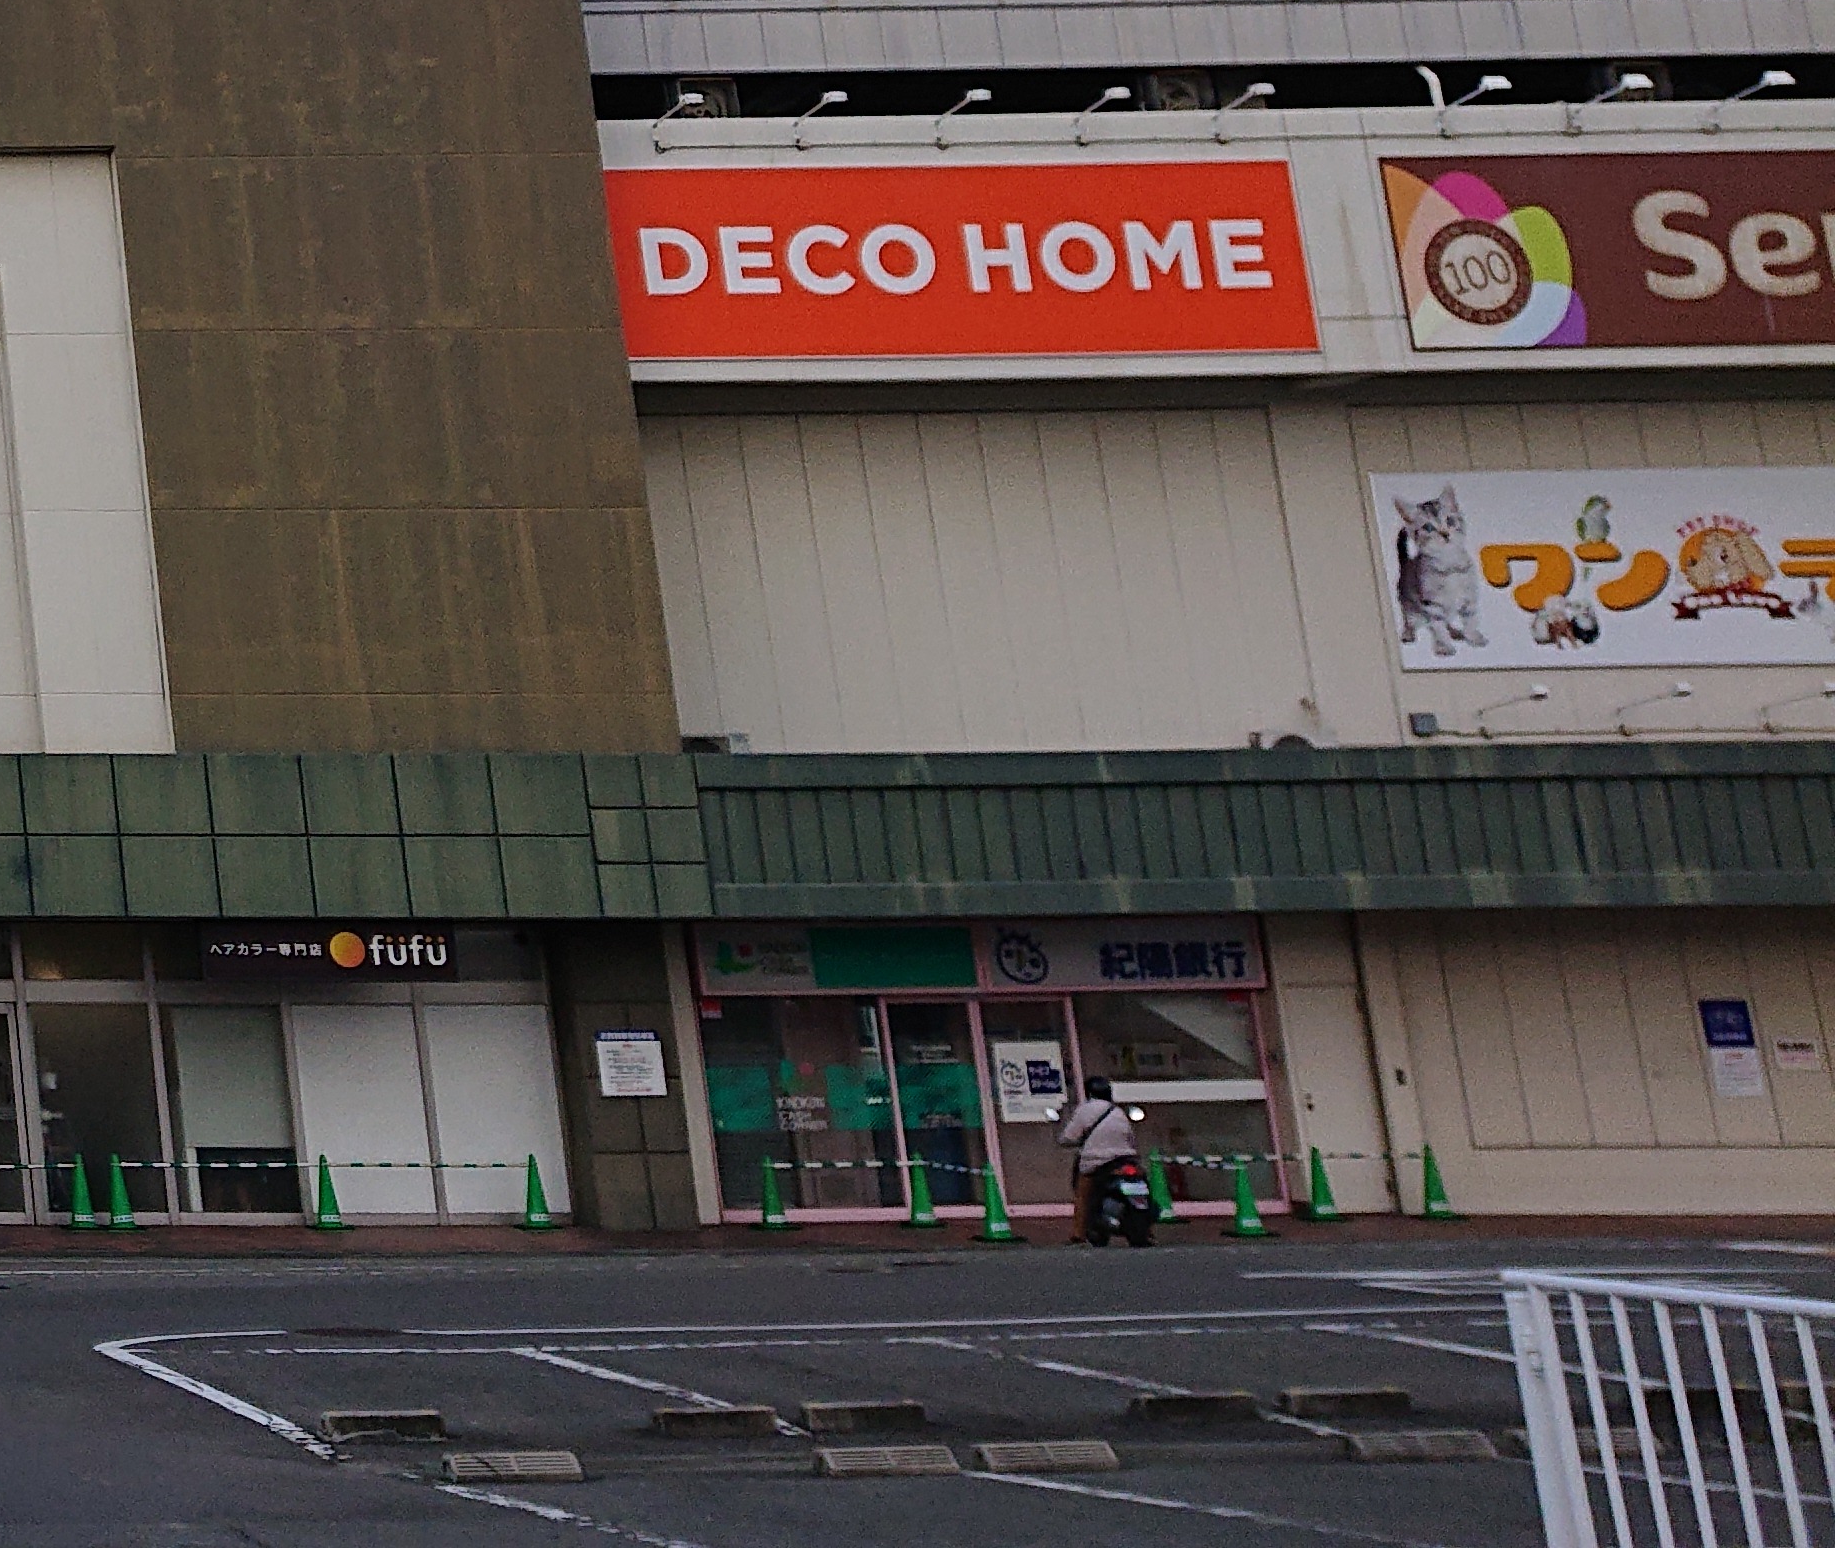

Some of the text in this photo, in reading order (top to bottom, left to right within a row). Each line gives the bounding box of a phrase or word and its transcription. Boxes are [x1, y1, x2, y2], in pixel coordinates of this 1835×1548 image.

[637, 217, 1274, 297] DECO HOME
[1444, 250, 1512, 296] 100
[1632, 189, 1835, 301] Se
